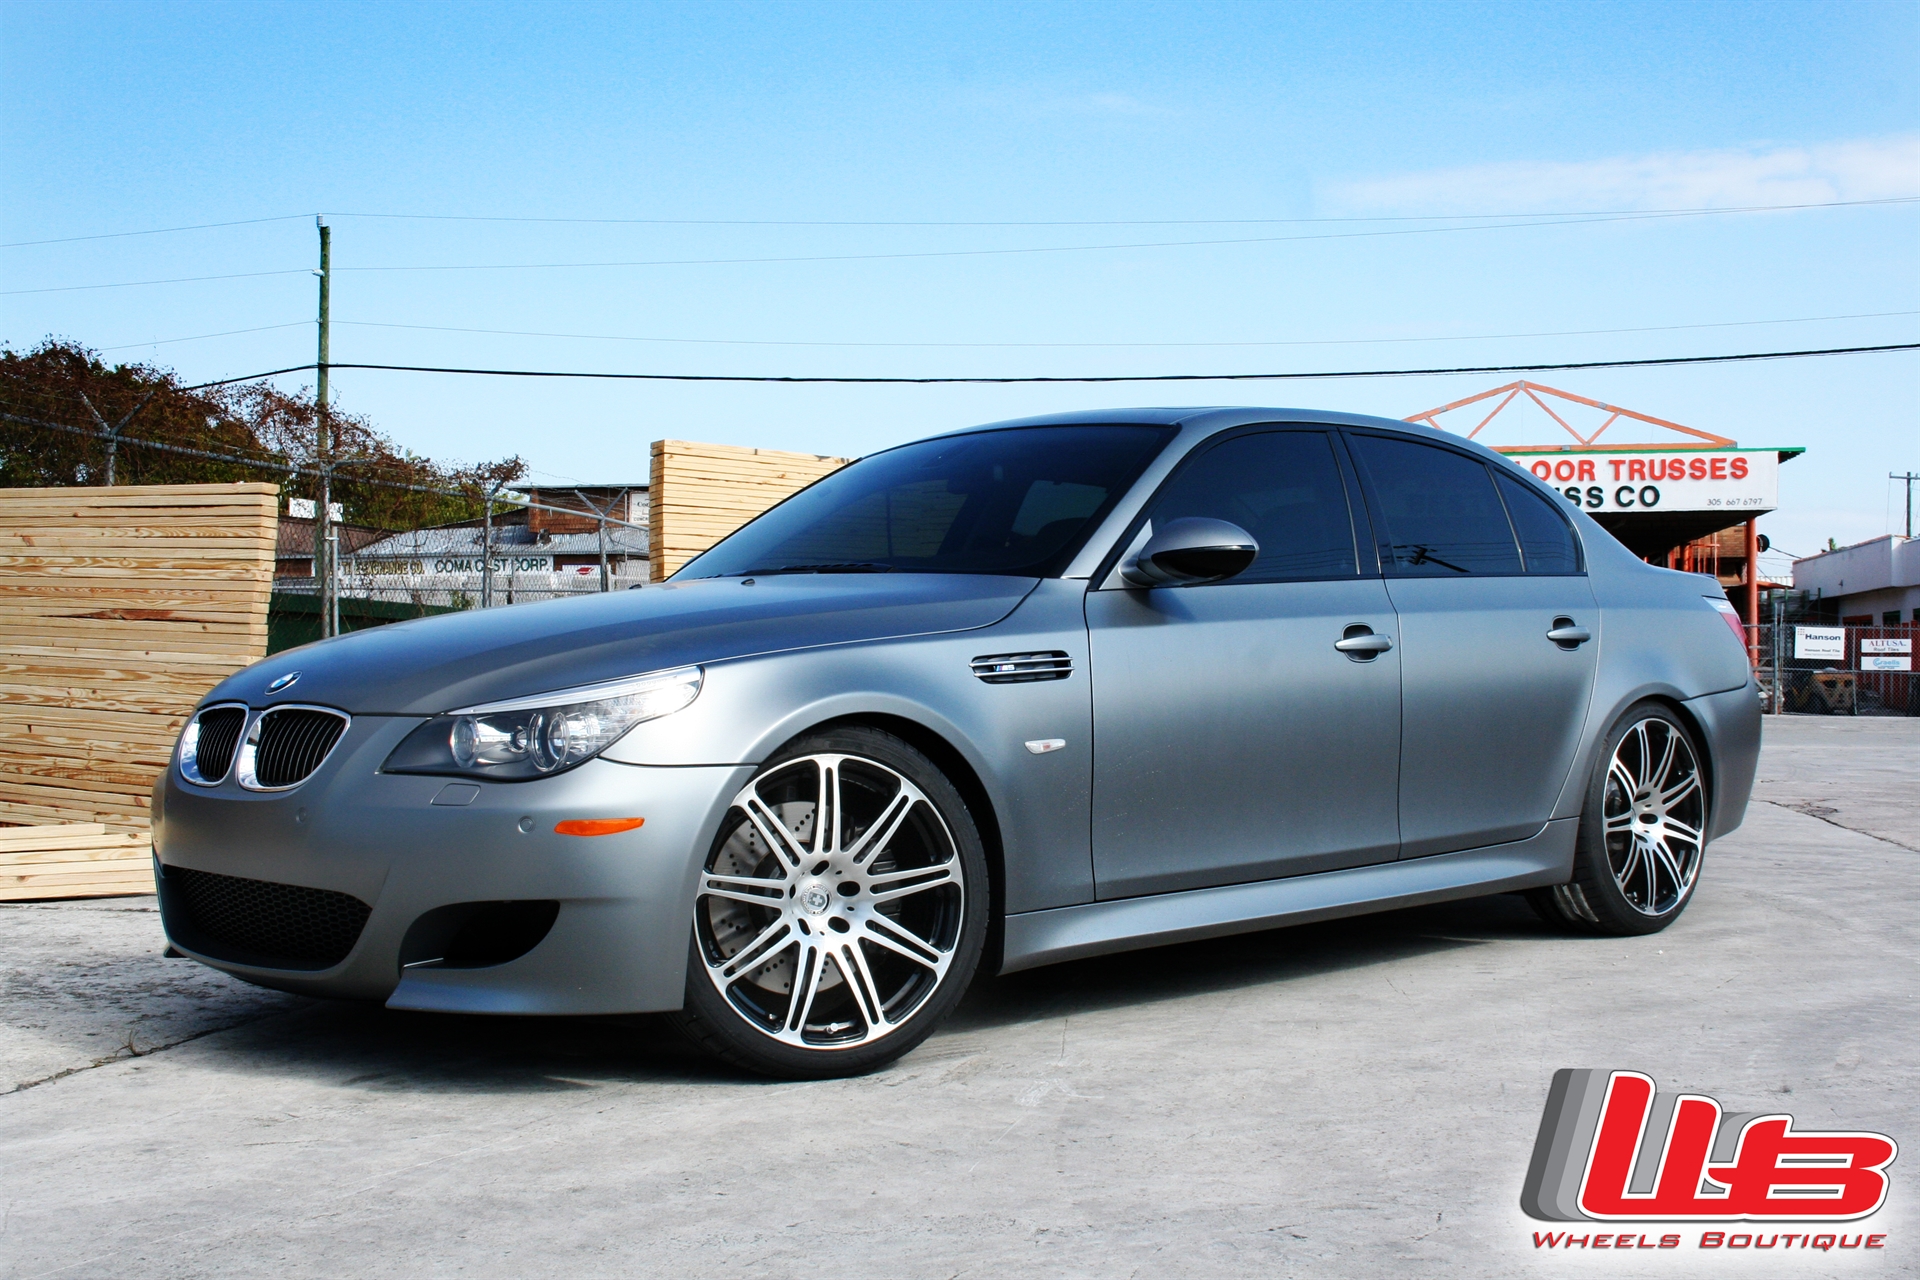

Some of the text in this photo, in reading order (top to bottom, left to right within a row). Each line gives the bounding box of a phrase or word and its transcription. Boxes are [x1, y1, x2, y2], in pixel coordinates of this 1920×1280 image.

[1516, 456, 1749, 482] OOR TRUSSES
[1555, 484, 1661, 508] SS CO
[1707, 497, 1763, 506] 305 667 6797
[434, 558, 472, 573] COMA
[474, 558, 509, 573] CST
[1805, 633, 1841, 641] Hanson
